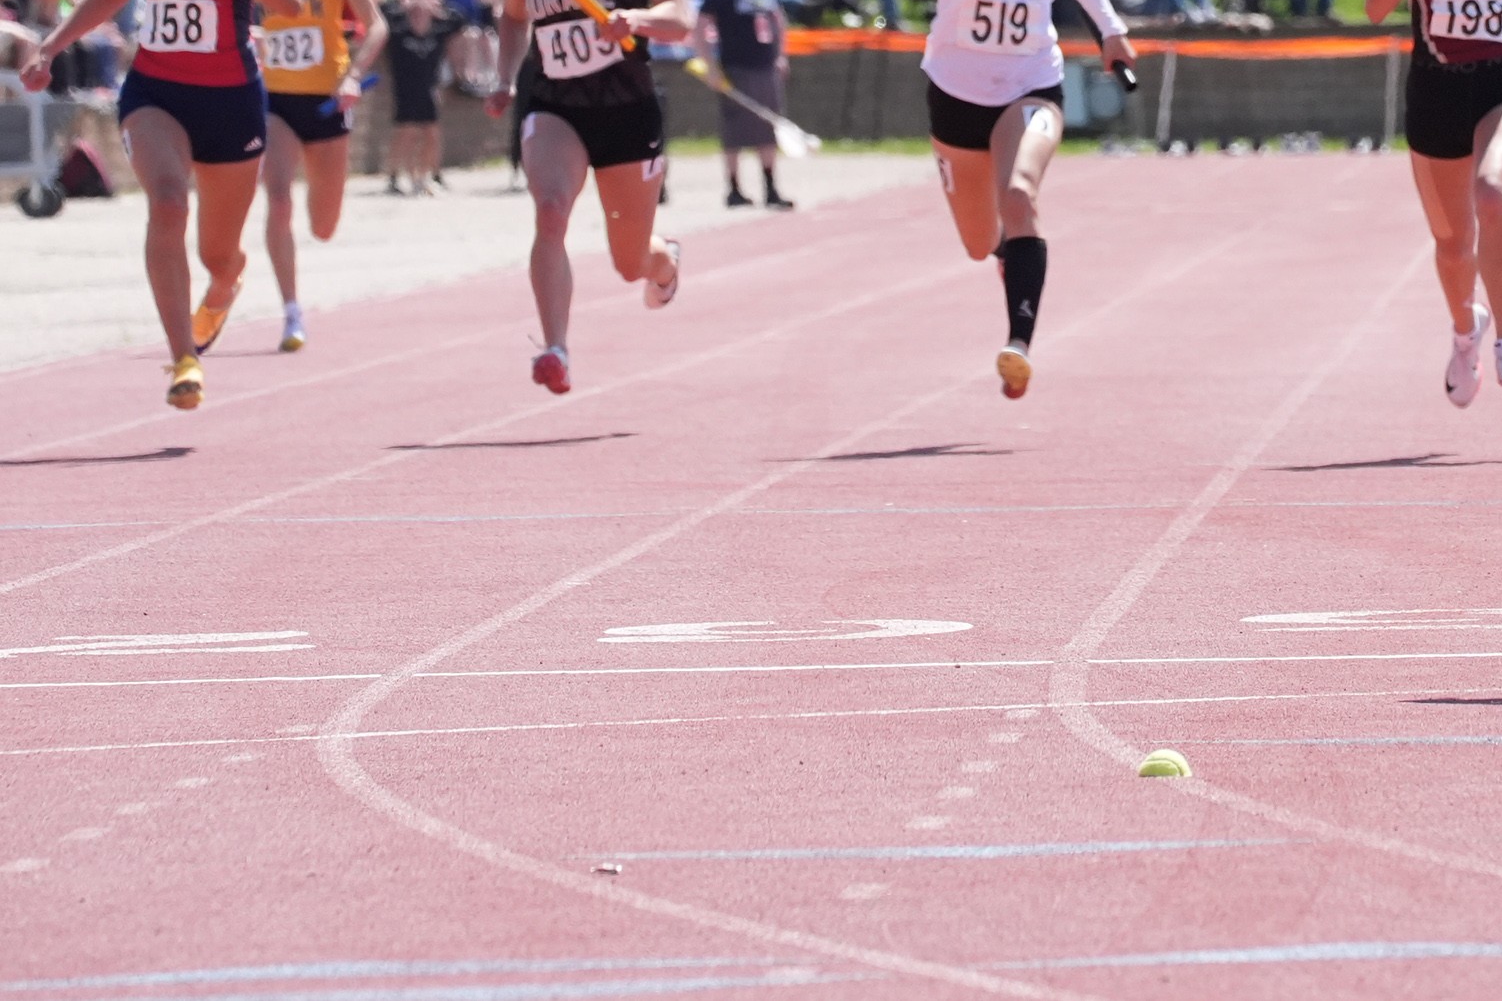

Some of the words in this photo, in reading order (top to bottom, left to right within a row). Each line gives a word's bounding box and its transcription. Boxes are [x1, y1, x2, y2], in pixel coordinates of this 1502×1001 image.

[150, 3, 202, 46] 158
[971, 0, 1029, 45] 519
[269, 32, 313, 66] 282
